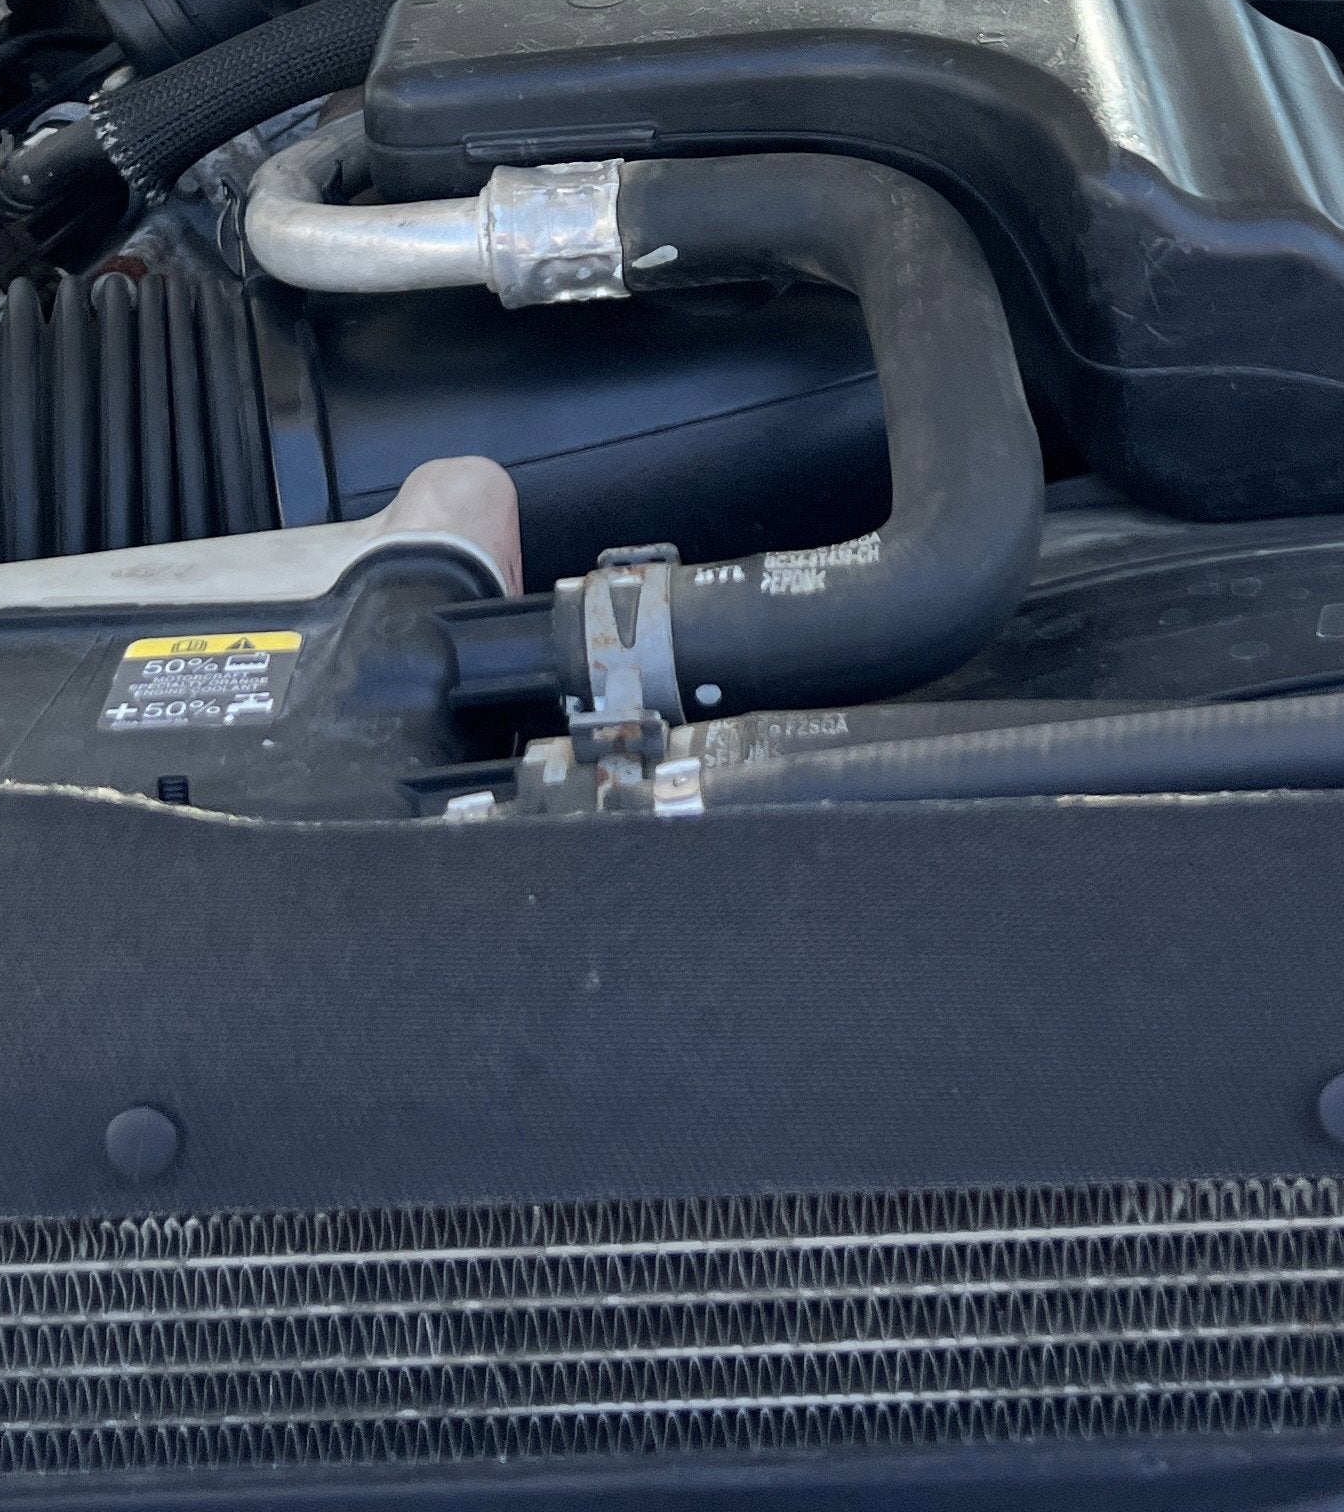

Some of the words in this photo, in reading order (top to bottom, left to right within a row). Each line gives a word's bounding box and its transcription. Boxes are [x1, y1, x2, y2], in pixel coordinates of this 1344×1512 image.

[143, 657, 218, 674] 50%
[128, 679, 203, 692] SPECIALTY
[208, 676, 269, 687] ORANGE
[152, 671, 250, 684] MOTORCRAFT
[133, 687, 185, 697] ENGINE
[189, 684, 258, 694] COOLANT
